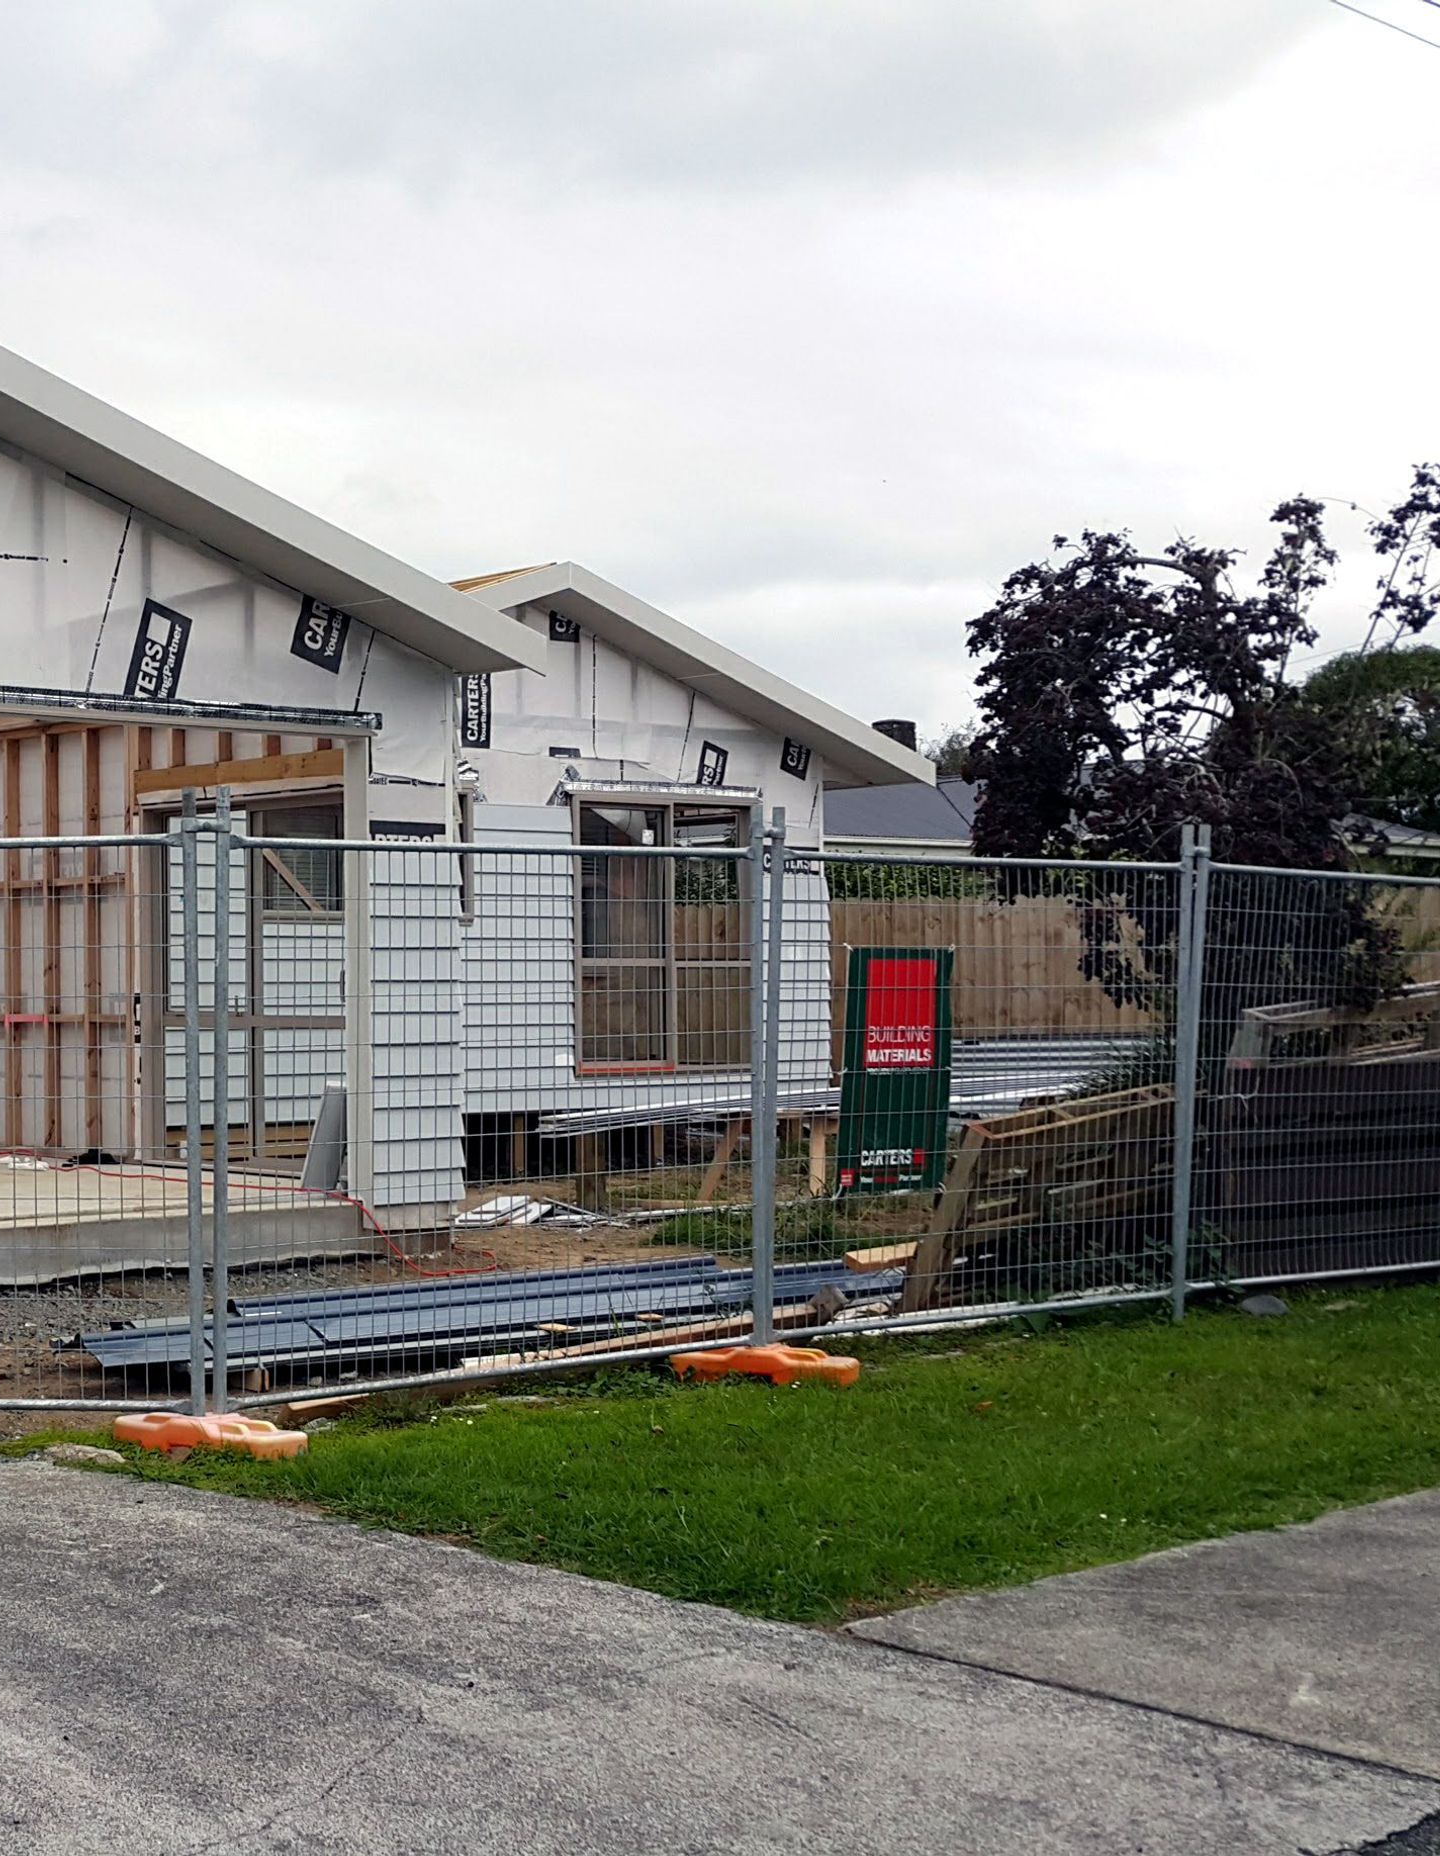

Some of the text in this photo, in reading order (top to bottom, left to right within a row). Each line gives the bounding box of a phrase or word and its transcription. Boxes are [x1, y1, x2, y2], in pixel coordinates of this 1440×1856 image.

[867, 1025, 931, 1044] BUILDING
[866, 1048, 932, 1063] MATERIALS
[861, 1149, 913, 1166] CARTERS
